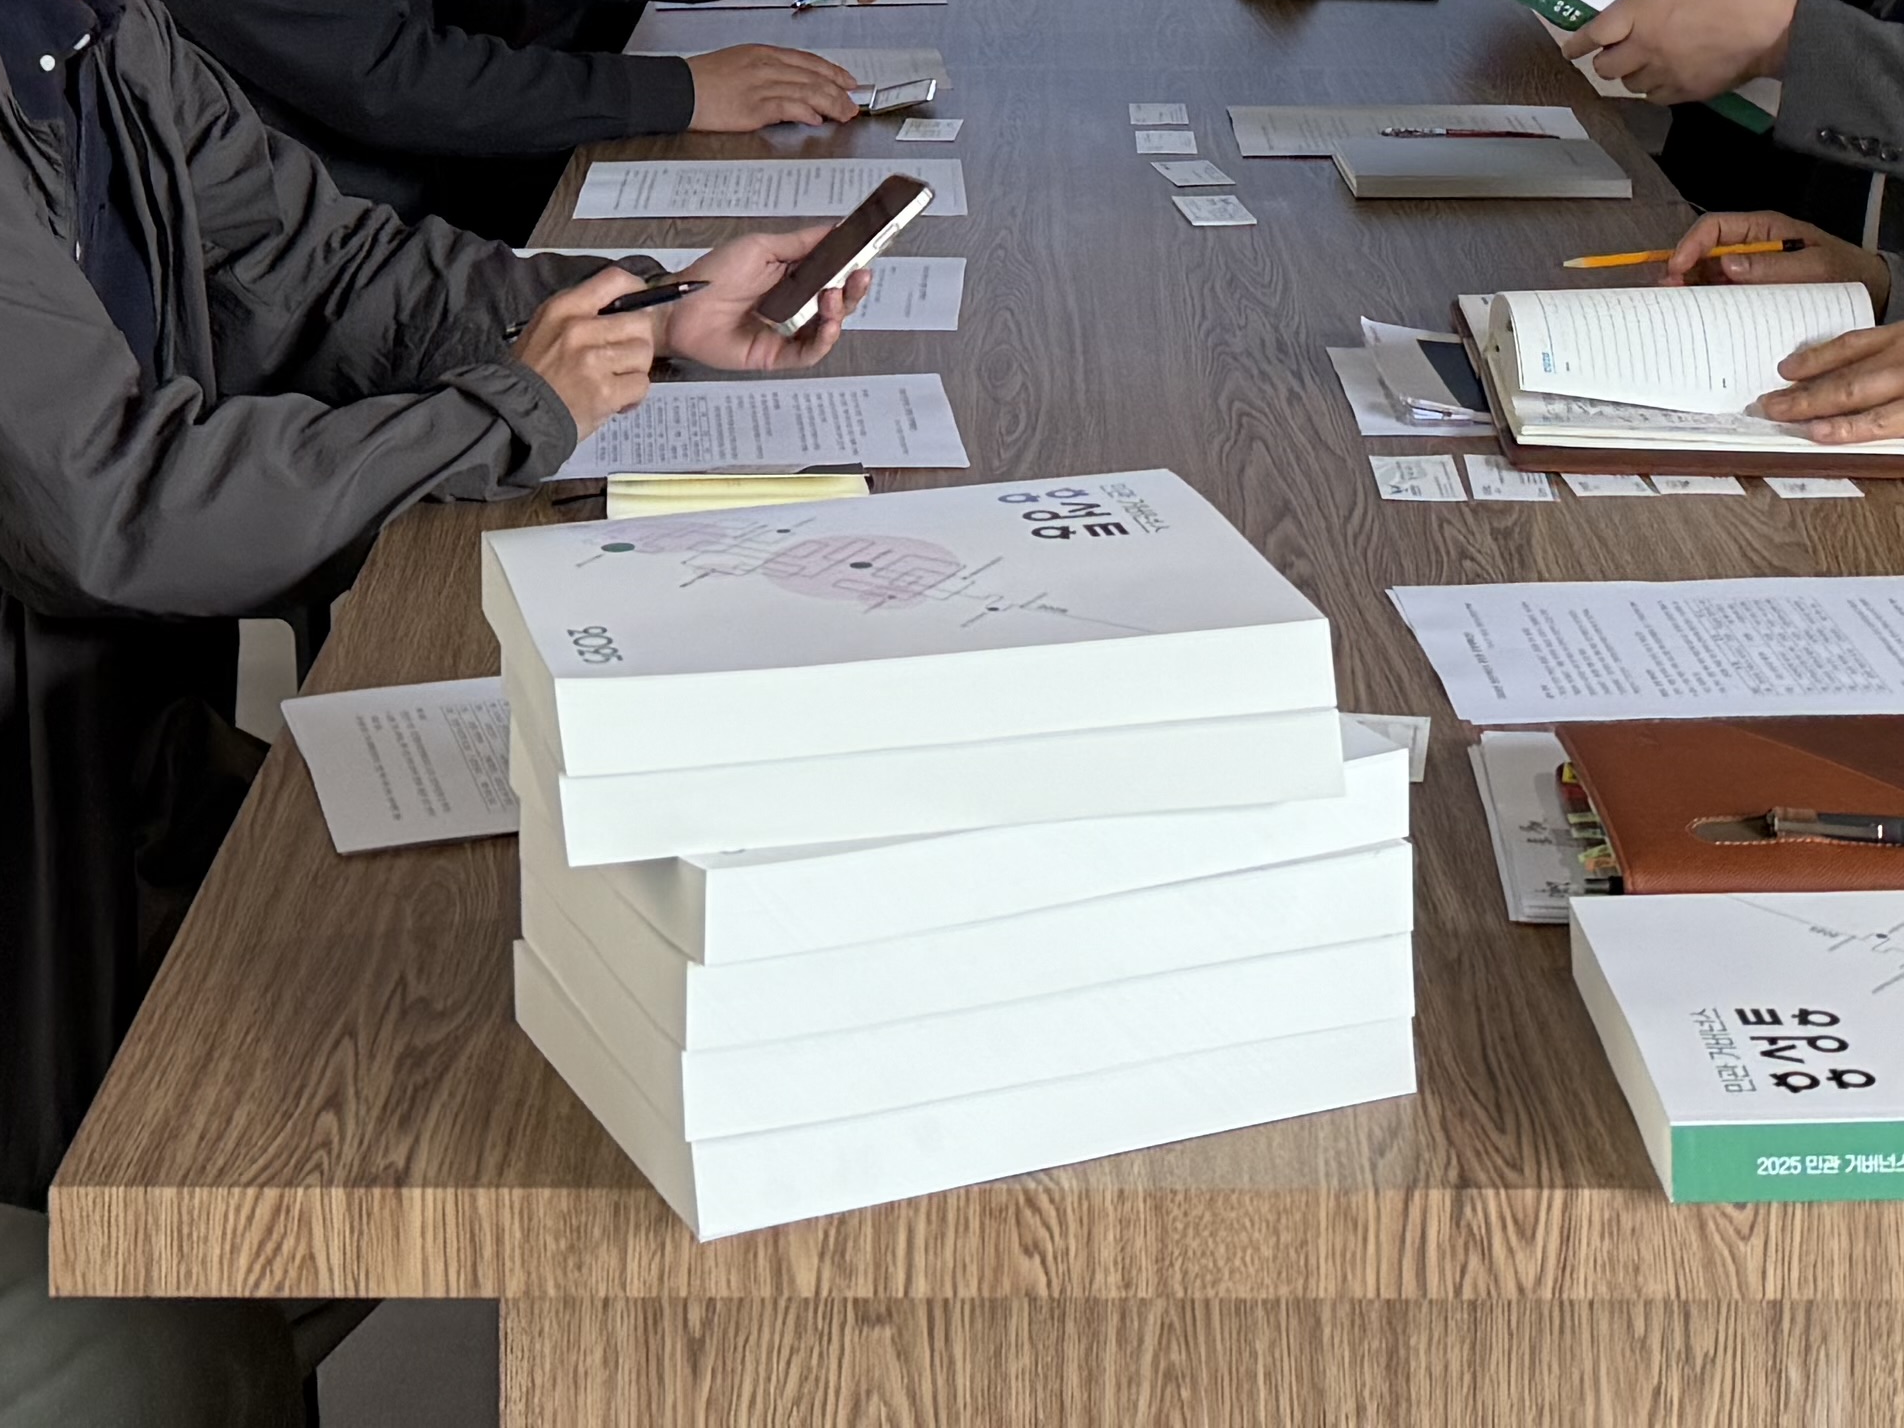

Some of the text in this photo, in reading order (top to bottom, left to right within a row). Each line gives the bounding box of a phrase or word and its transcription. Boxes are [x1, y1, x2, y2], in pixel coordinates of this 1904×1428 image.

[567, 626, 624, 665] 2025
[1690, 1006, 1745, 1057] 거버넌스
[1735, 1005, 1877, 1094] 홍성통
[1757, 1154, 1801, 1176] 2025
[1806, 1153, 1839, 1175] 민관
